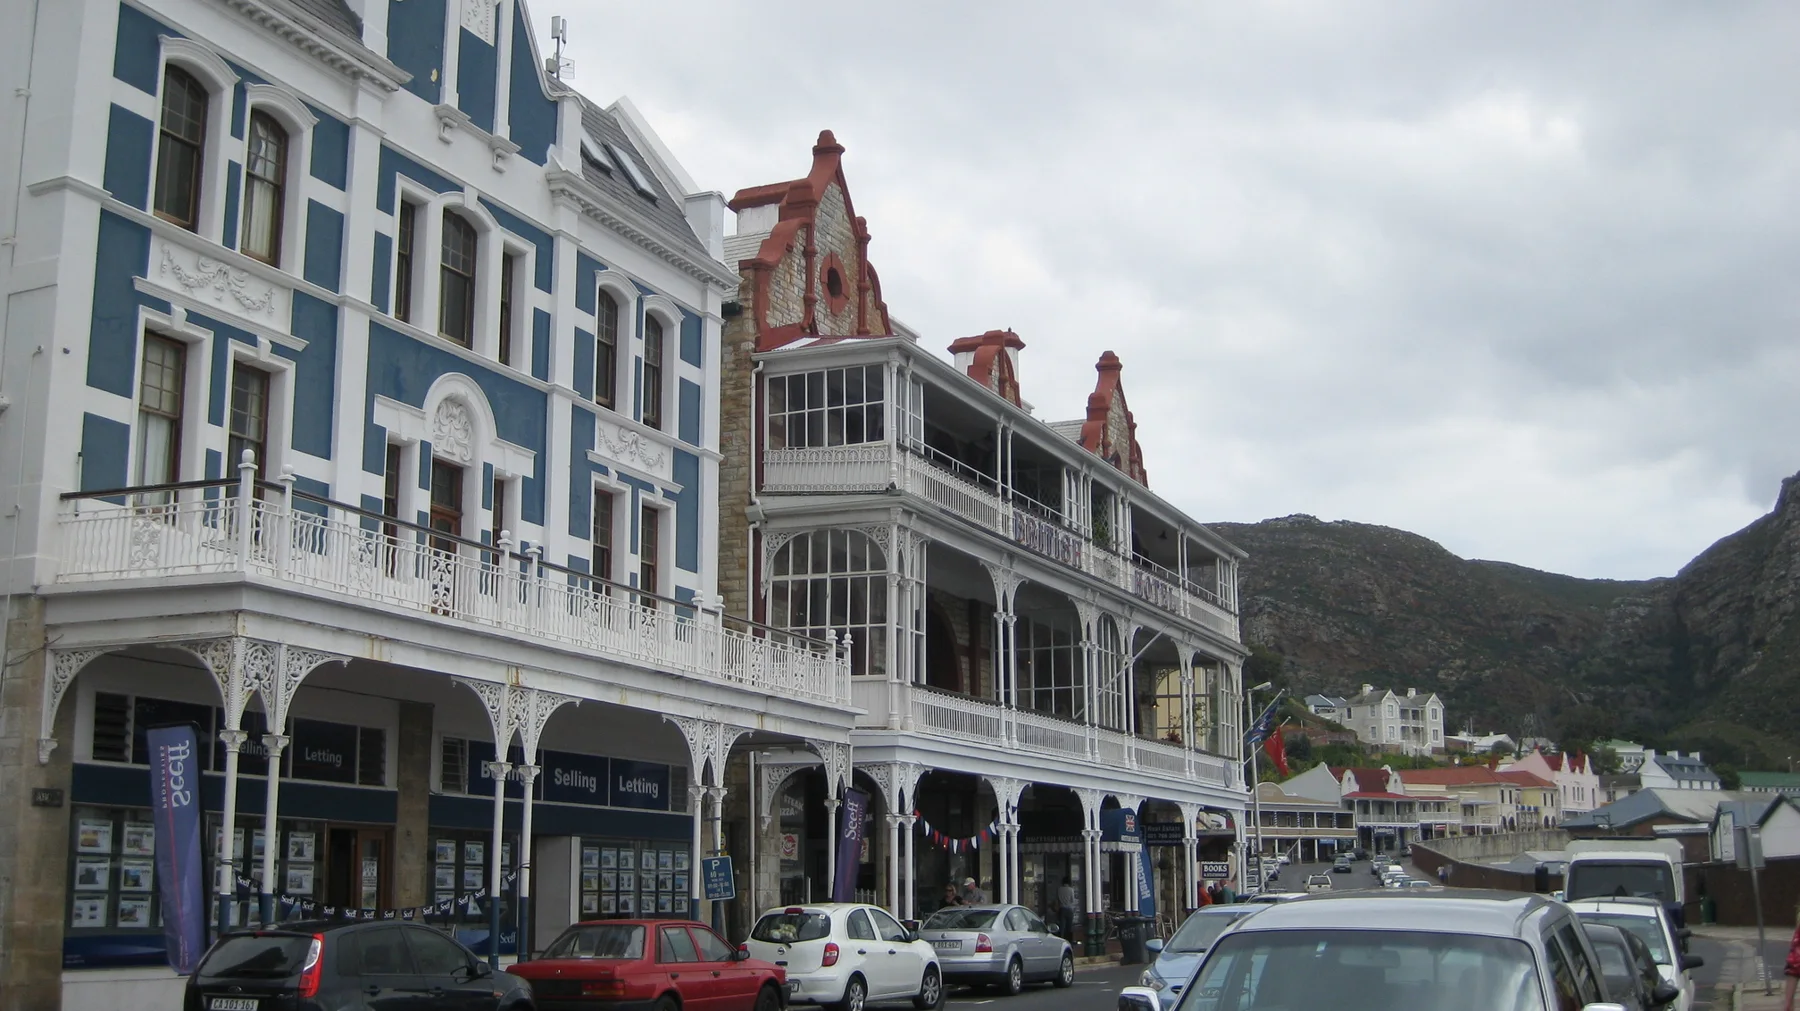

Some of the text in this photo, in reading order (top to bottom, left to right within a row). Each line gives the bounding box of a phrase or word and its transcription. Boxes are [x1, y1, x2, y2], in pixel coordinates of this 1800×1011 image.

[1012, 510, 1083, 570] BRITISH
[305, 747, 342, 767] Letting
[554, 767, 597, 793] Selling
[619, 775, 659, 799] Letting
[844, 798, 859, 840] Seeff
[712, 860, 720, 870] P
[1203, 864, 1228, 872] BOOKS
[474, 887, 486, 899] Seeff
[458, 895, 468, 906] Seeff
[423, 906, 433, 915] Seeff
[499, 931, 517, 944] Seeff
